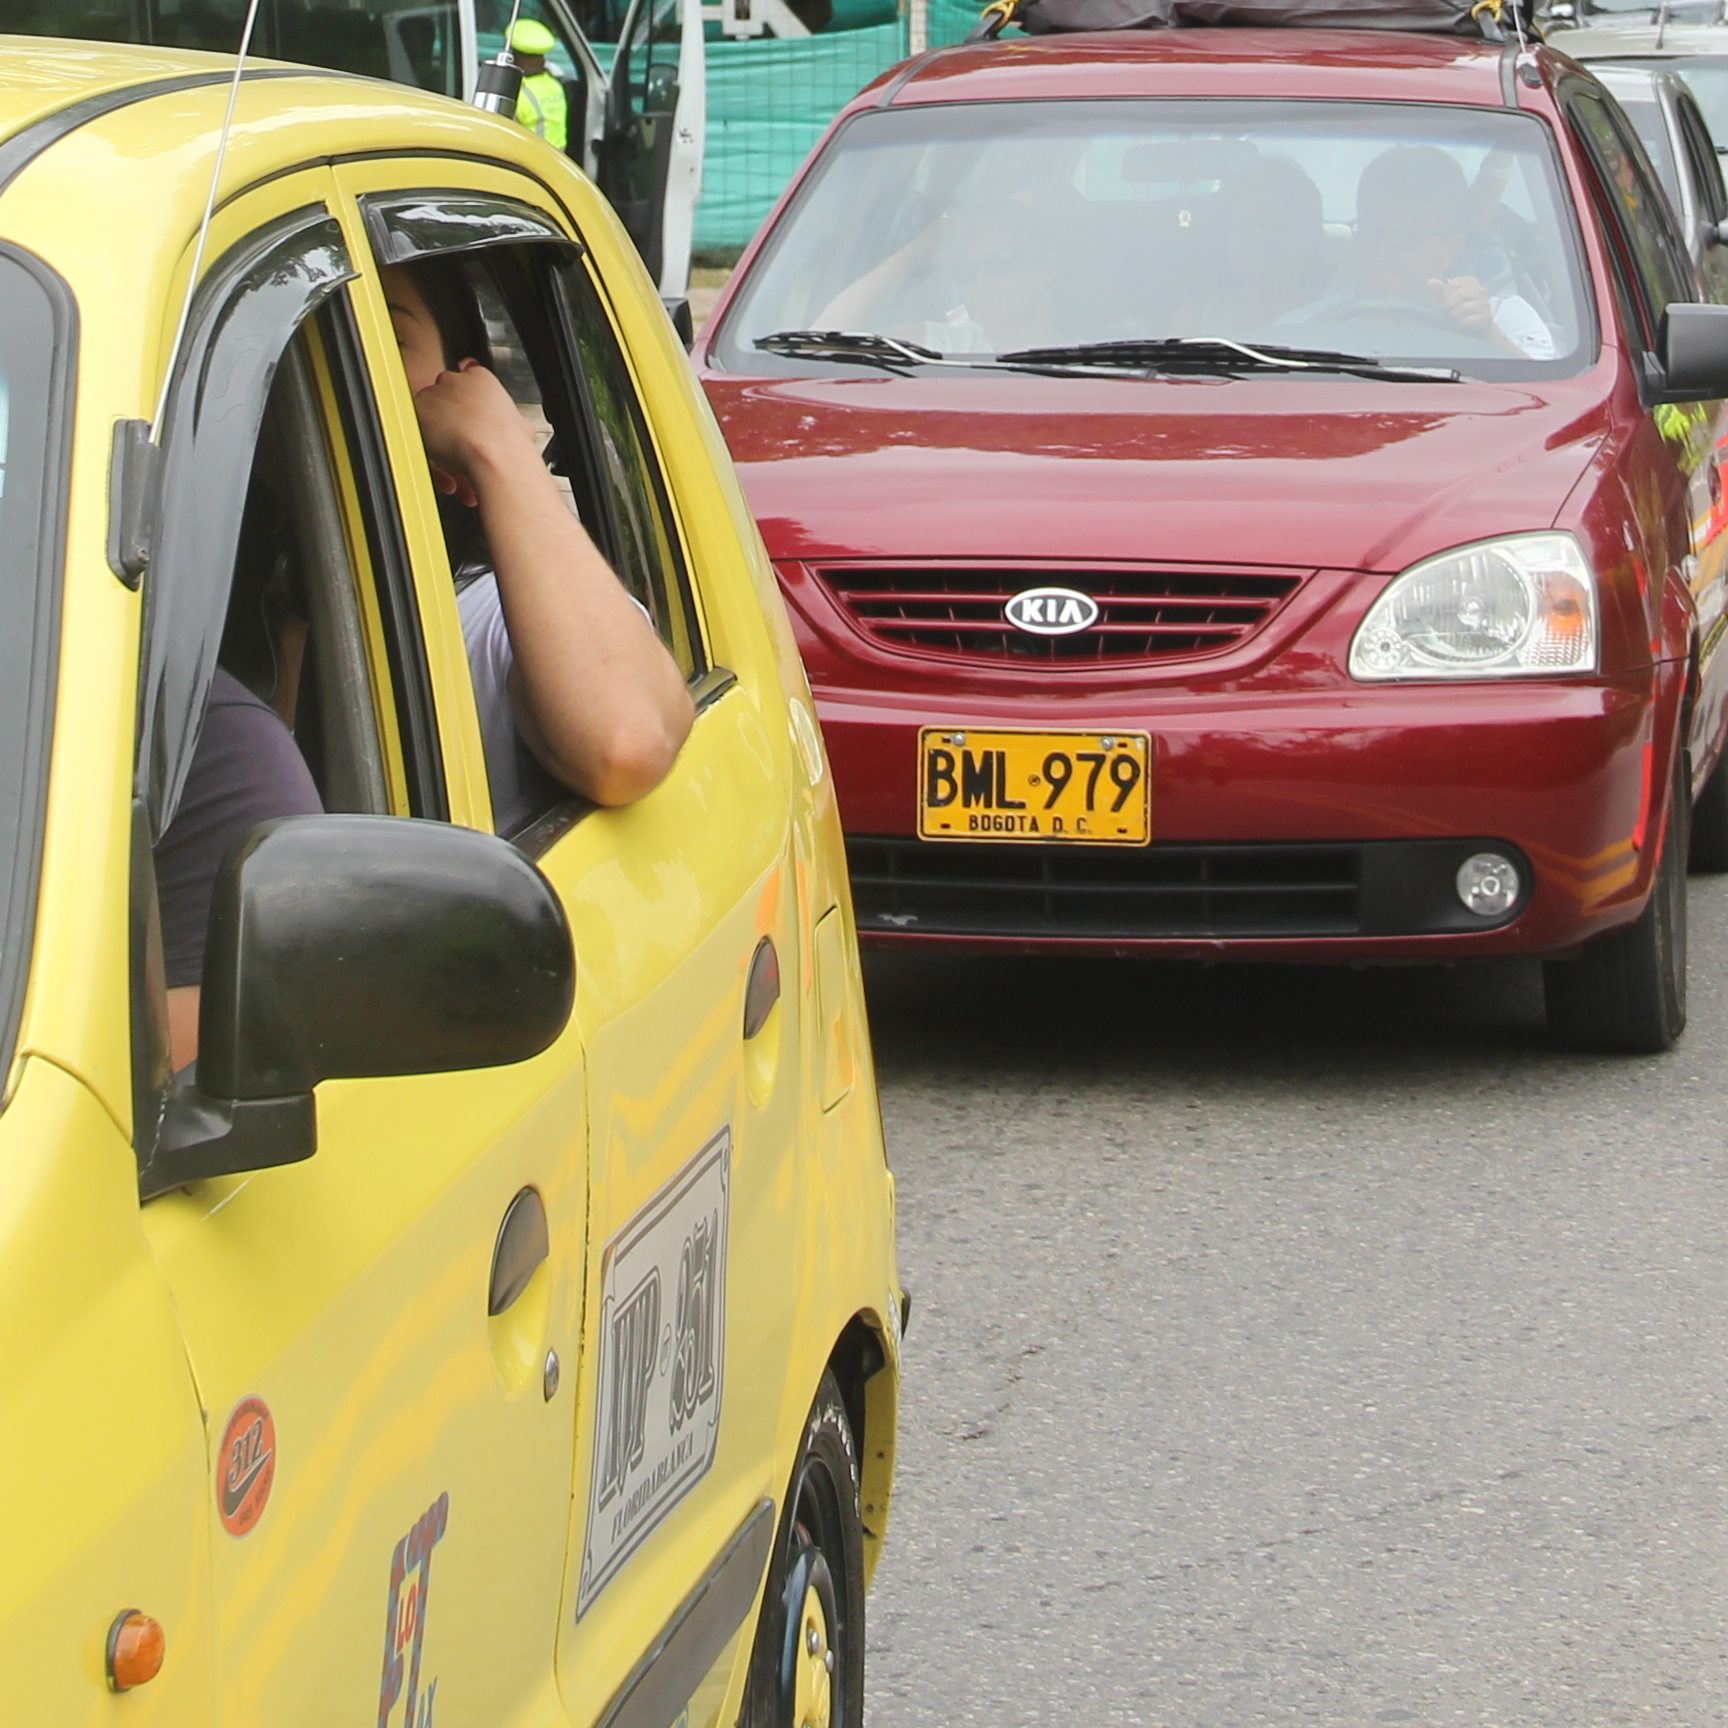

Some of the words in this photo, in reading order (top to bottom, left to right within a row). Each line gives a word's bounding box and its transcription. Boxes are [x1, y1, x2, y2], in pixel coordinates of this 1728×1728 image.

[1022, 599, 1083, 623] KIA
[926, 747, 1027, 809] BML
[1042, 751, 1141, 812] 979
[968, 814, 1040, 833] BOGOTA
[610, 1430, 695, 1545] FLORIDABLANCA
